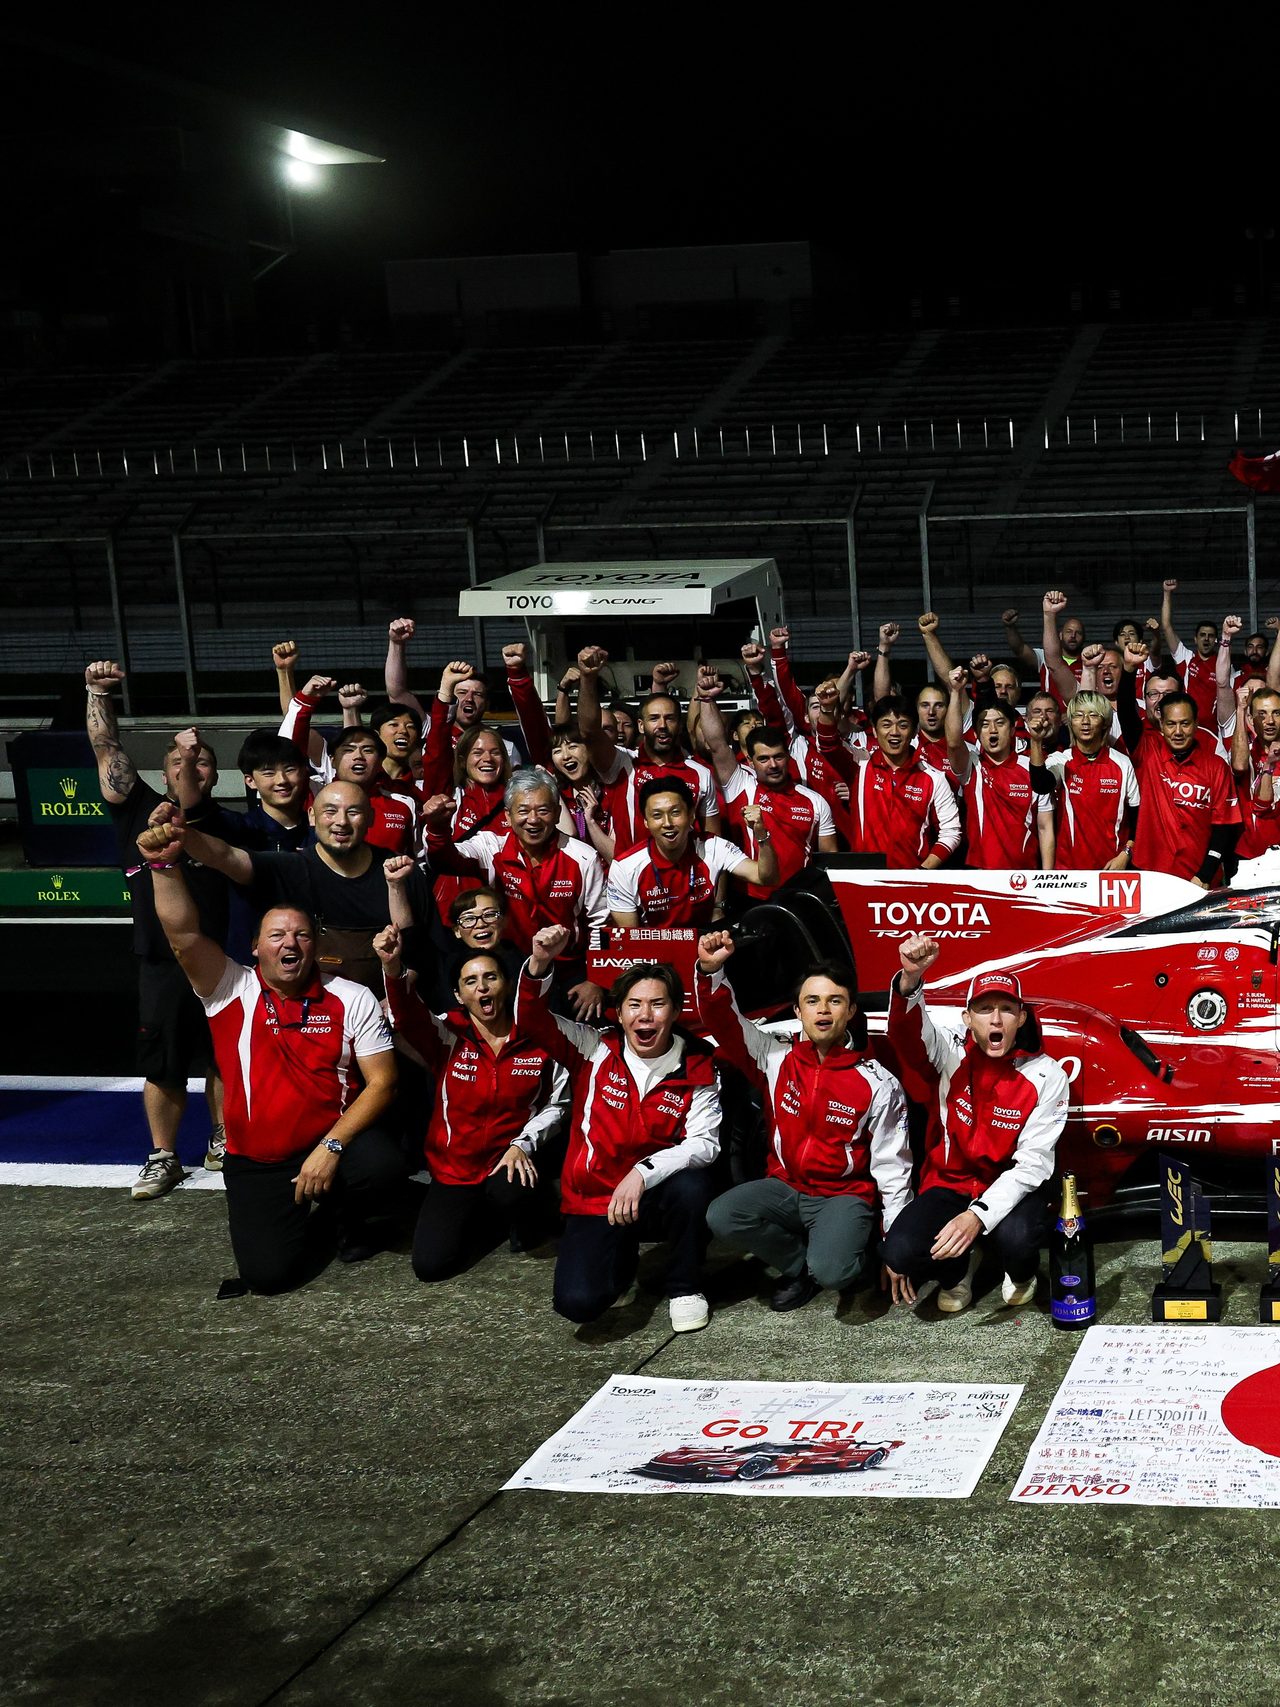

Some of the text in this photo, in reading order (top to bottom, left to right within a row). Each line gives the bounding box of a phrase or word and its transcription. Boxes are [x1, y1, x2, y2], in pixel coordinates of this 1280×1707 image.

[40, 802, 104, 816] ROLEX
[791, 814, 812, 822] DENSO
[385, 822, 406, 830] DENSO
[1034, 881, 1088, 889] AIRLINES
[38, 891, 81, 901] ROLEX
[1102, 879, 1139, 908] HY
[867, 902, 991, 926] TOYOTA
[869, 930, 991, 939] RACING
[978, 975, 1013, 985] TOYOTA
[300, 1026, 332, 1034] DENSO
[512, 1057, 543, 1065] TOYOTA
[510, 1068, 542, 1077] DENSO
[827, 1100, 856, 1113] TOYOTA
[993, 1105, 1022, 1116] TOYOTA
[825, 1114, 853, 1126] DENSO
[991, 1119, 1020, 1131] DENSO
[1146, 1128, 1211, 1142] AISIN
[1167, 1167, 1184, 1226] WEC
[612, 1386, 656, 1395] TOYOTA
[967, 1392, 1010, 1401] FUJITSU
[788, 1420, 864, 1439] TR!
[1017, 1483, 1131, 1498] DENSO
